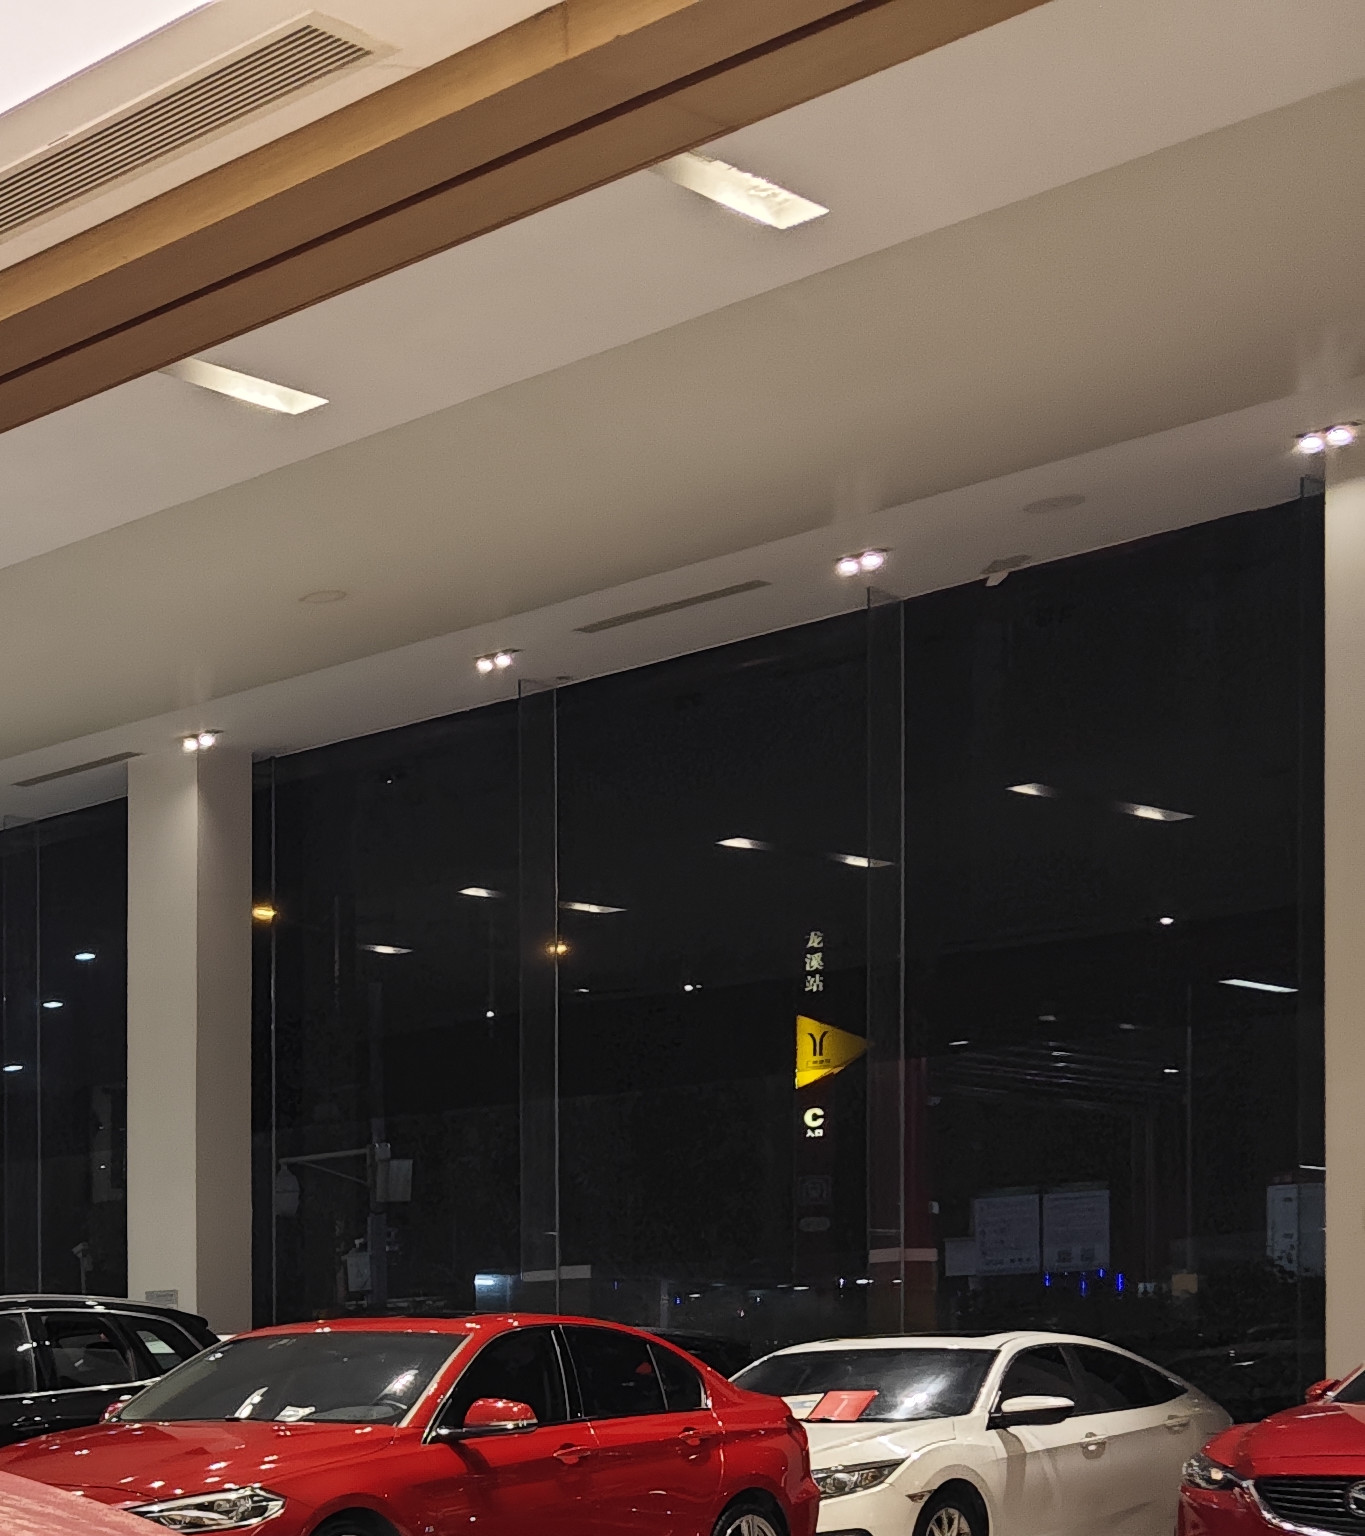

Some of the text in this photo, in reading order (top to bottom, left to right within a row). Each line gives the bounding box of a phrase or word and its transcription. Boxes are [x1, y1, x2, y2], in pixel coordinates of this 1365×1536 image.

[803, 930, 825, 993] 龙溪站
[803, 1107, 824, 1128] C
